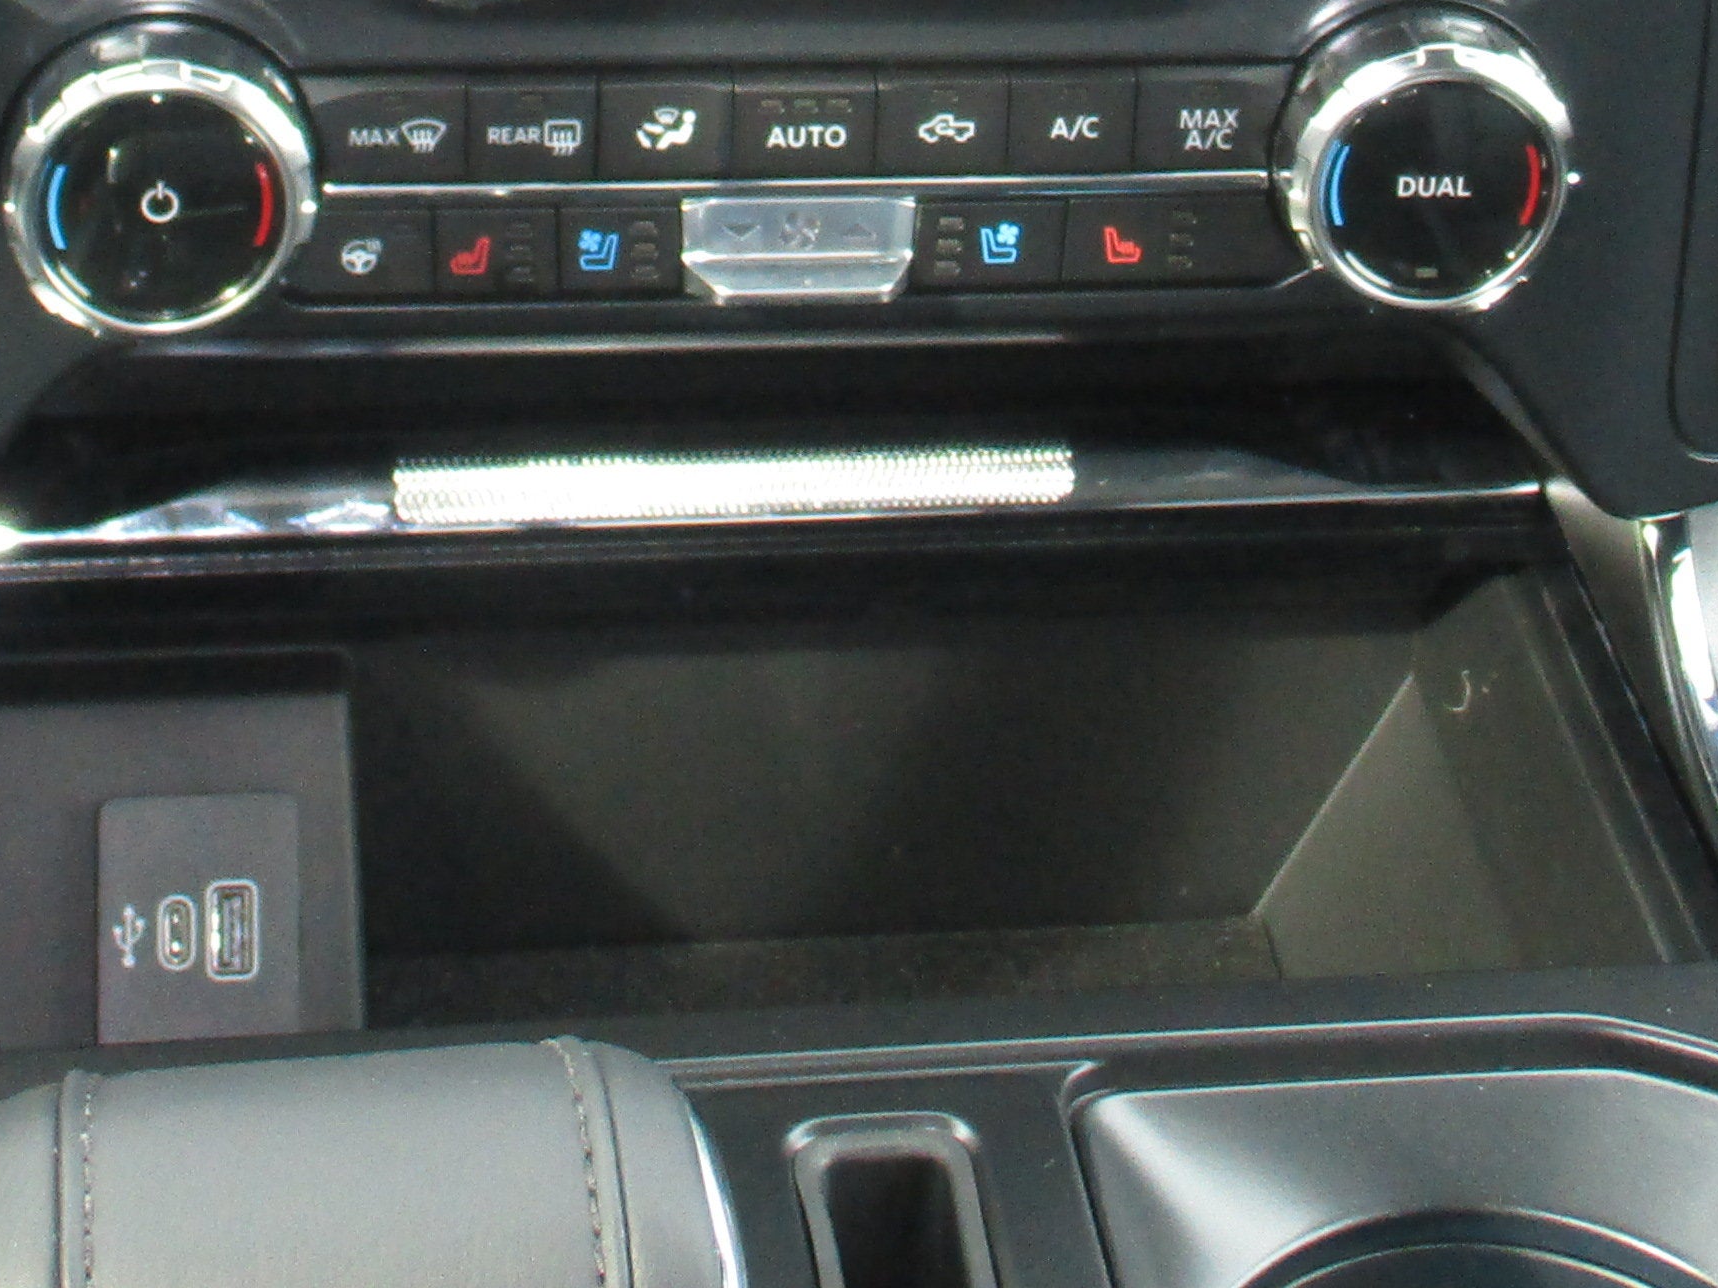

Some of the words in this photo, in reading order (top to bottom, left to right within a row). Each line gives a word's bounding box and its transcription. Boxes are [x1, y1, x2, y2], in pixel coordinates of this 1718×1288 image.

[1050, 115, 1101, 142] A/C
[1179, 108, 1239, 129] MAX
[348, 127, 401, 148] MAX
[486, 126, 541, 147] REAR
[766, 124, 847, 149] AUTO
[1184, 128, 1234, 152] A/C
[1396, 175, 1473, 199] DUAL
